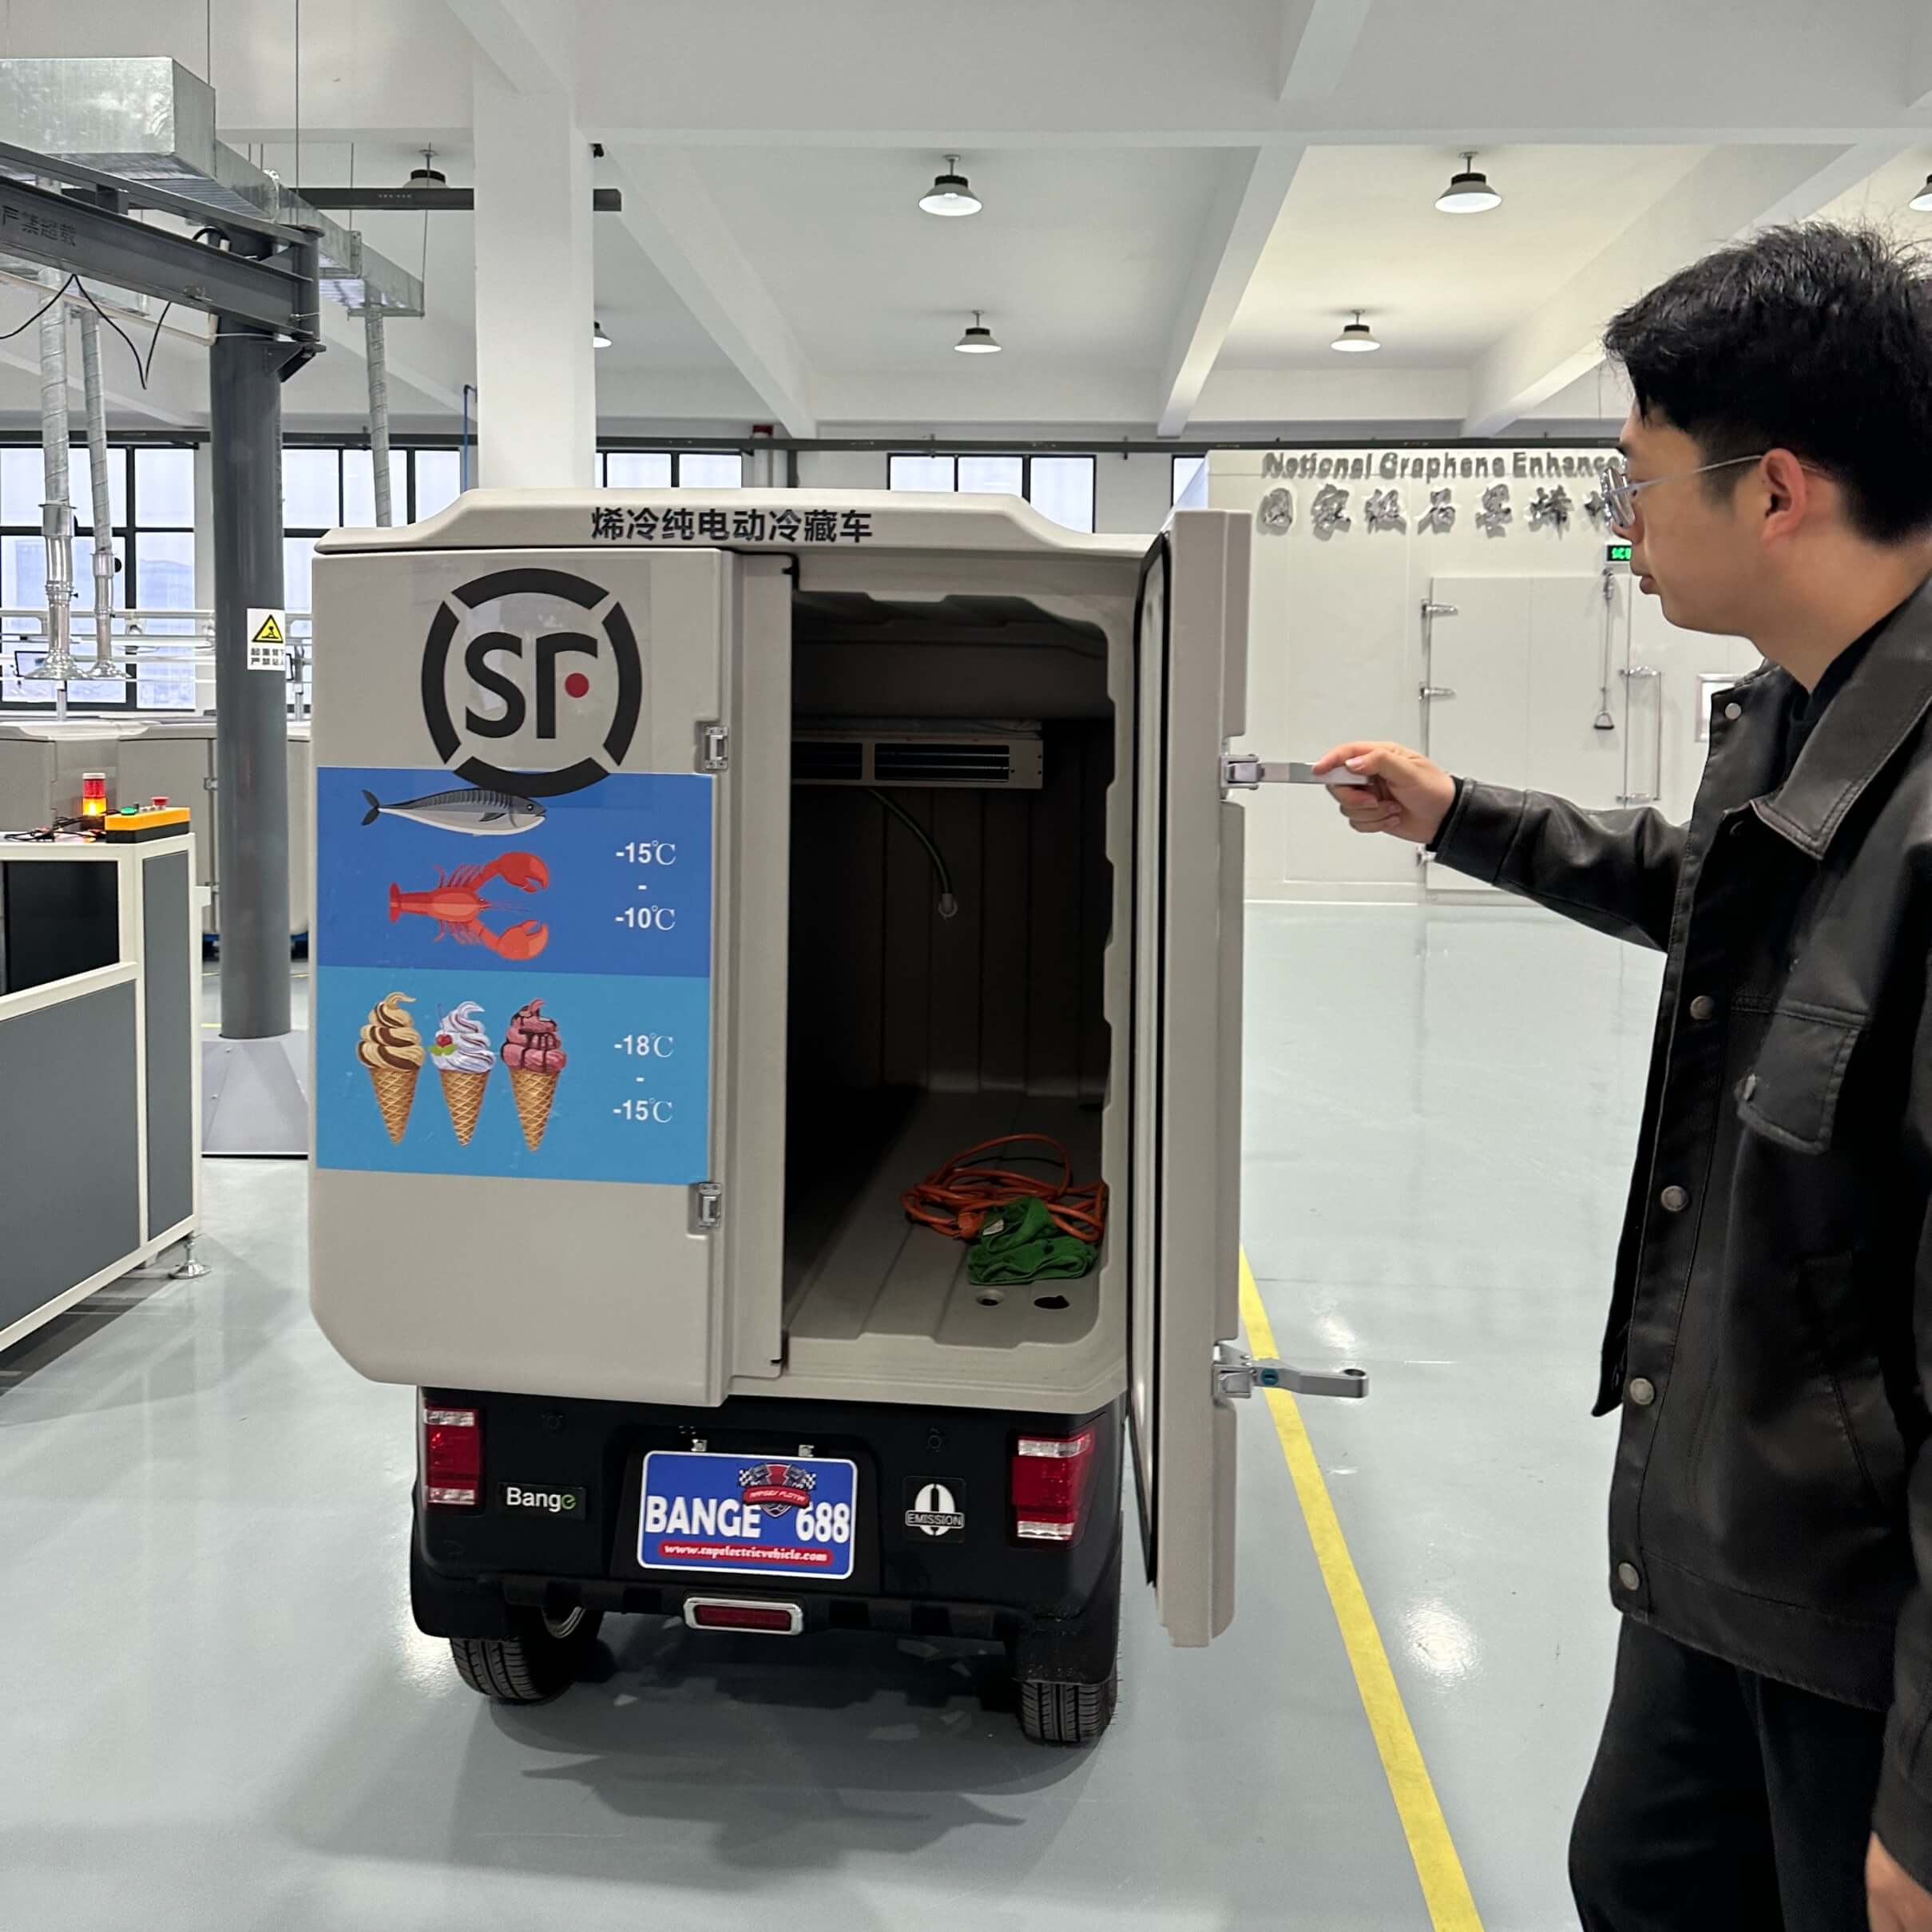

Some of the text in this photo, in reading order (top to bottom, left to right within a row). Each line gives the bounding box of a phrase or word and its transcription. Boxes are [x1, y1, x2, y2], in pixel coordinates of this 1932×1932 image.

[1261, 451, 1372, 479] National
[1379, 451, 1505, 484] Graphene
[591, 506, 873, 543] 烯冷纯电动冷藏车
[506, 1487, 576, 1513] Bange
[645, 1495, 851, 1544] BANGE 688
[907, 1513, 963, 1525] EMISSION
